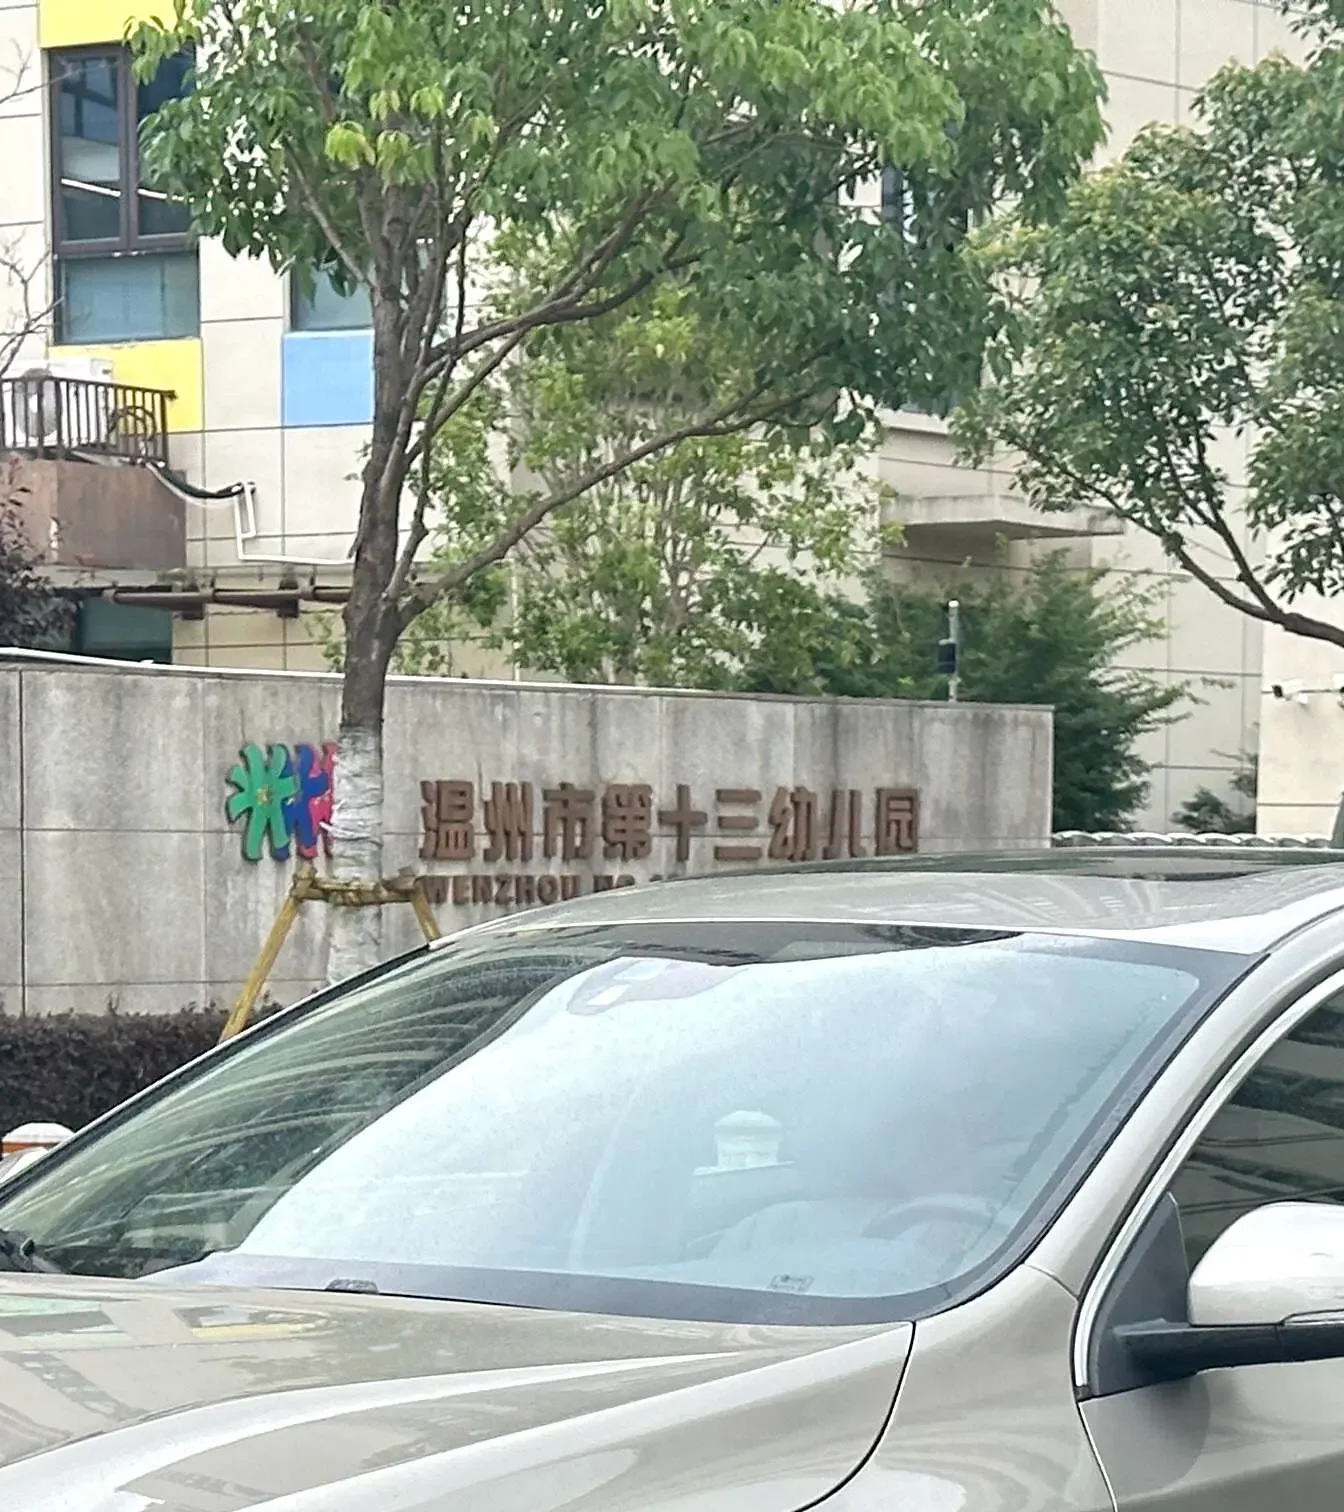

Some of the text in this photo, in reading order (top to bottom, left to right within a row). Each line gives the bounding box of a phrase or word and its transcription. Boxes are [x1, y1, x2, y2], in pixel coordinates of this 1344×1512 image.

[419, 779, 920, 862] 温州市第十三幼儿园
[419, 874, 581, 904] WENZHOU
